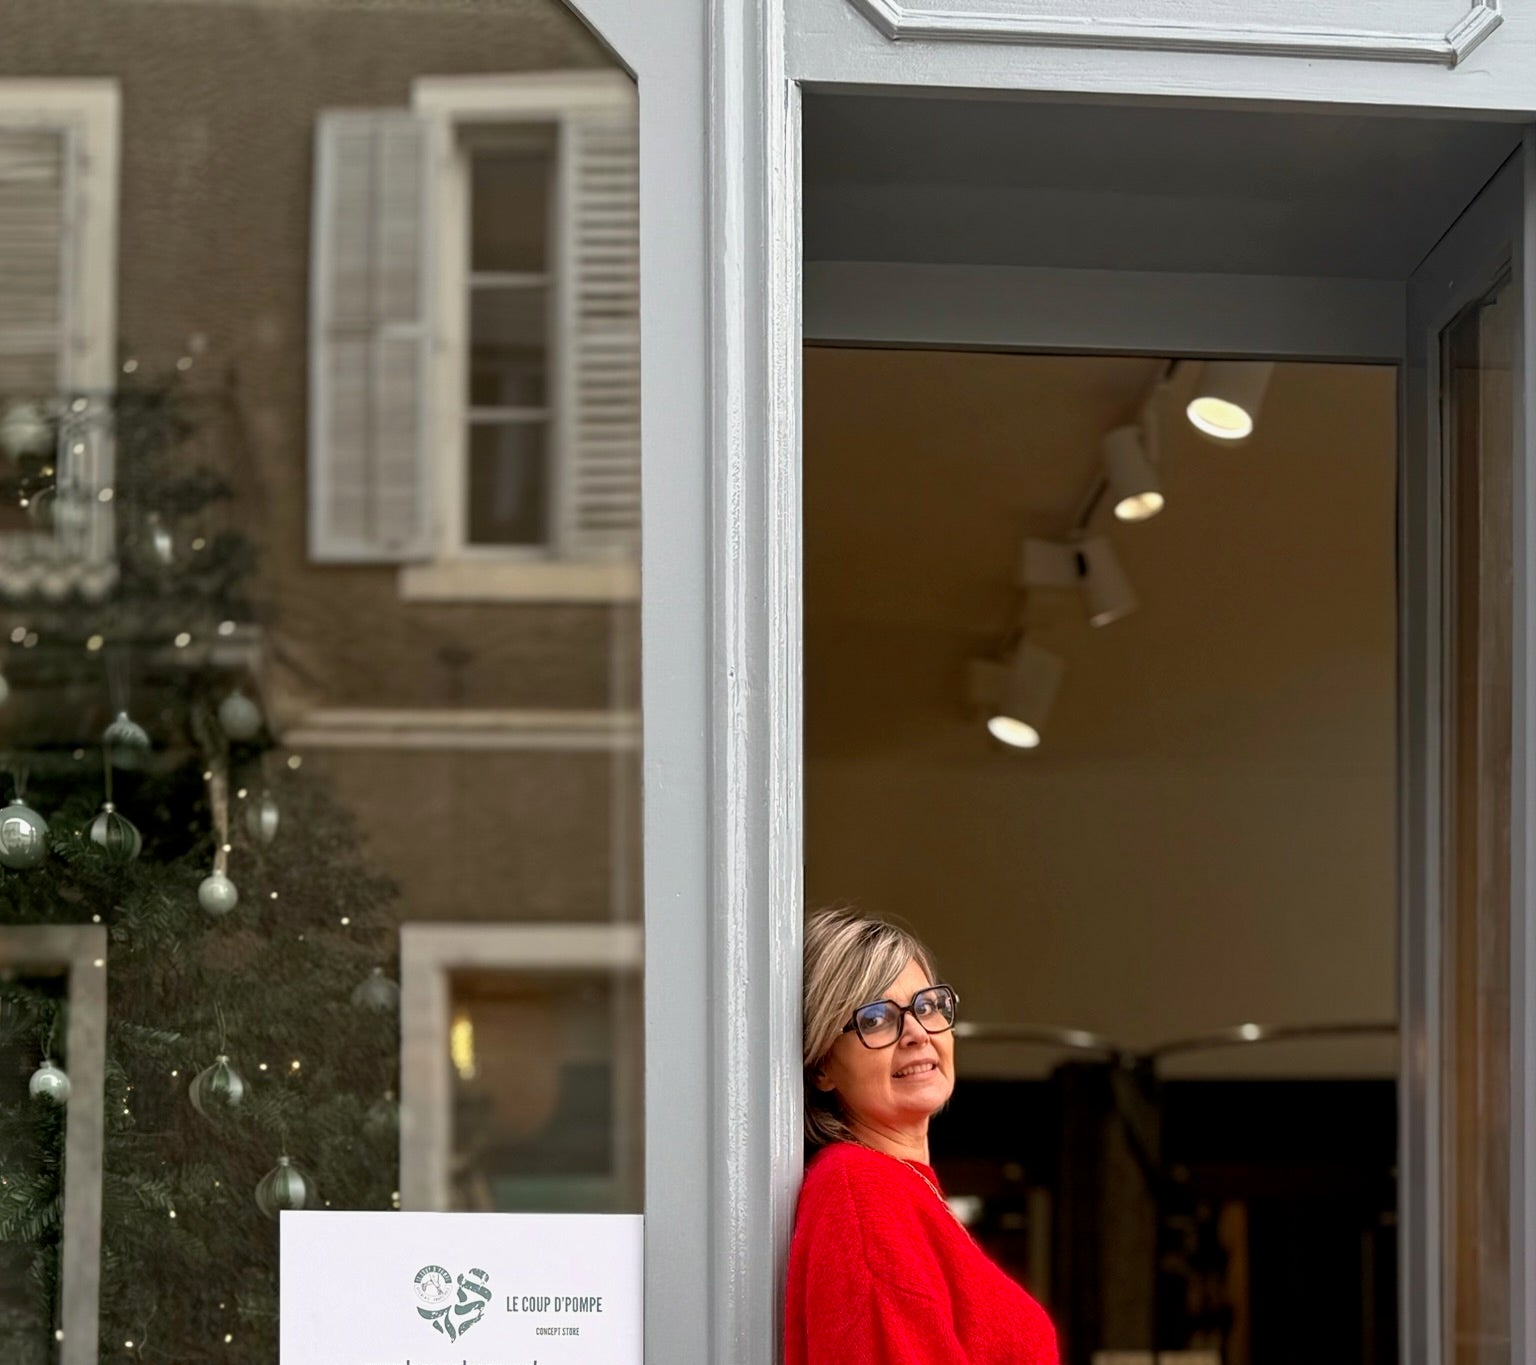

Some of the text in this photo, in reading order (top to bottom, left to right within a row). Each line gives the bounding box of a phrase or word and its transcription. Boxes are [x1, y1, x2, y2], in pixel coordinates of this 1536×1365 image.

[506, 1296, 603, 1313] LE COUP D'POMPE
[535, 1327, 580, 1336] CONCEPT STORE
